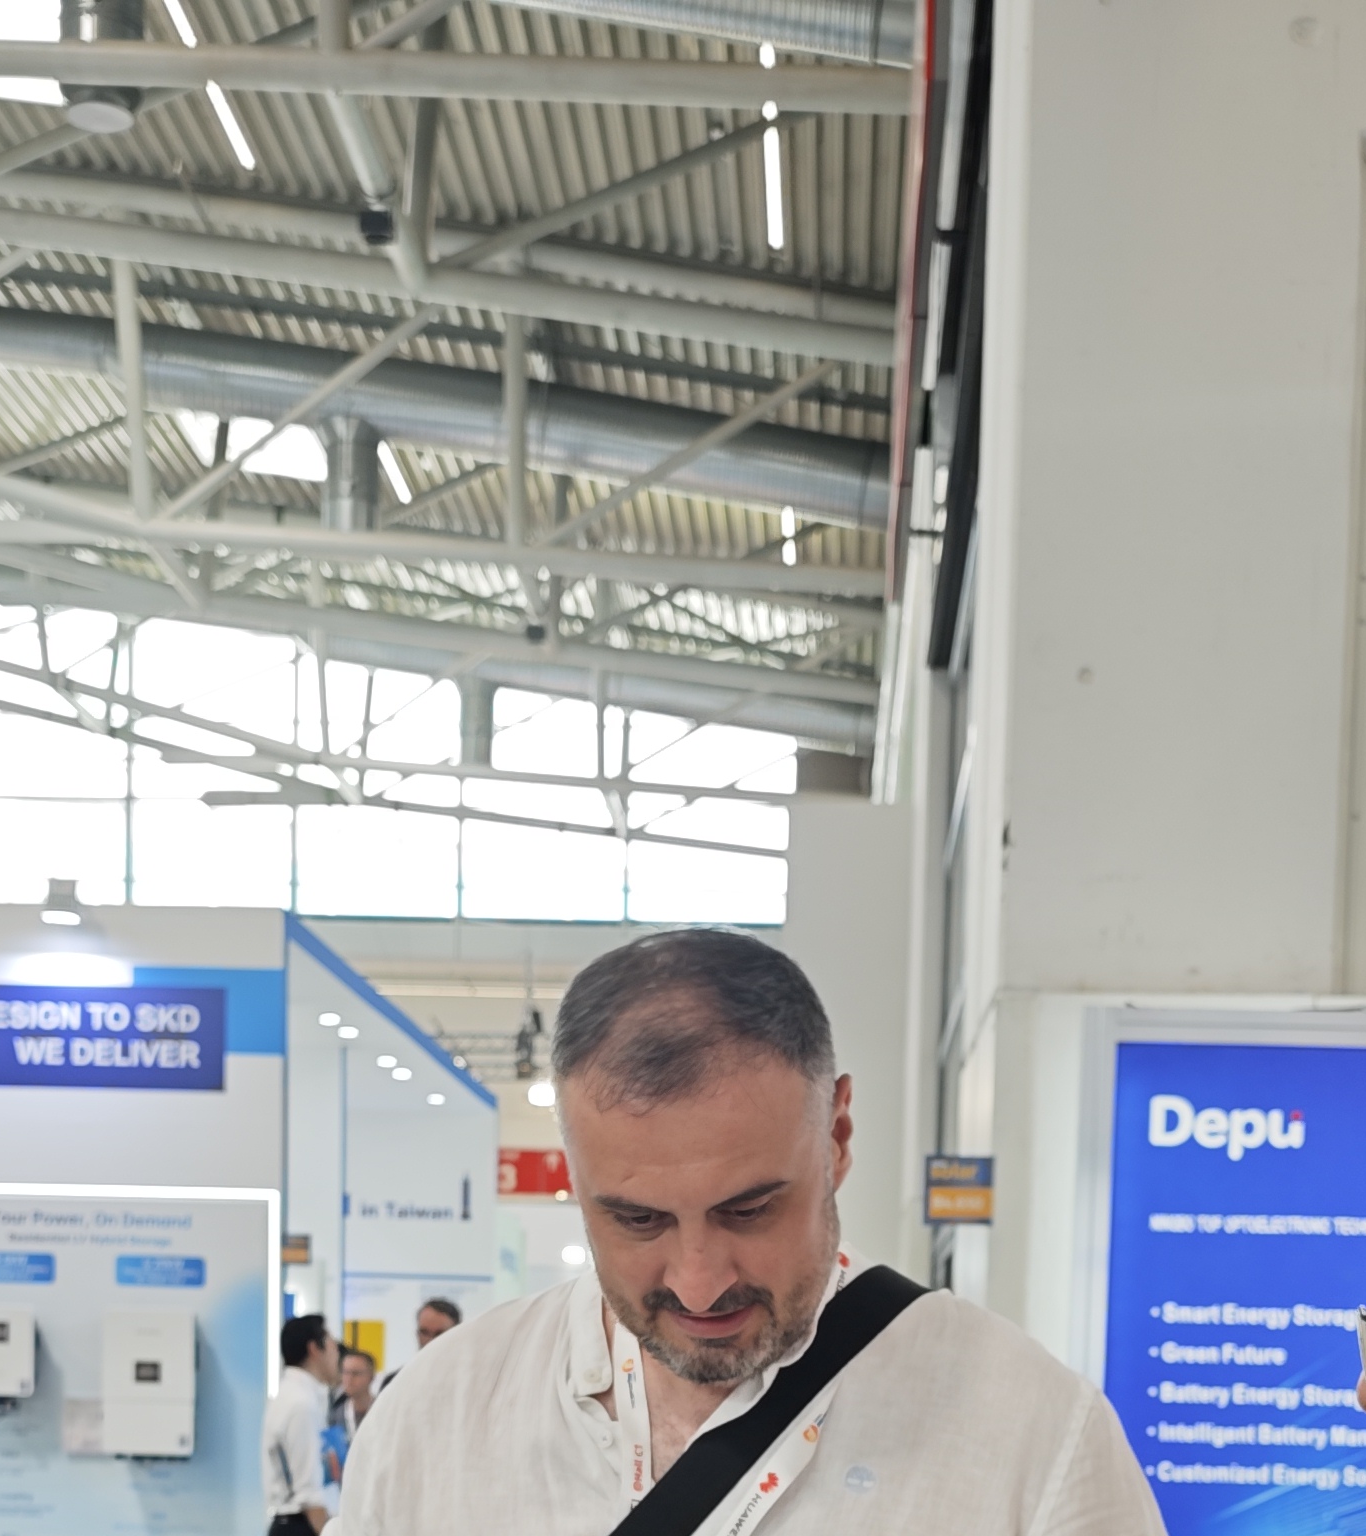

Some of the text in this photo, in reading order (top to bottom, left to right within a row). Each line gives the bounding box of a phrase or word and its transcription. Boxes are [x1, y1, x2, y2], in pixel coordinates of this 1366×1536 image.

[84, 1001, 131, 1032] TO
[135, 1002, 202, 1034] SKD
[12, 1035, 202, 1070] WE DELIVER
[386, 1202, 453, 1220] Taiwan
[1162, 1301, 1358, 1332] Smart Energy Storag
[1160, 1340, 1287, 1366] Green Future
[1159, 1380, 1362, 1412] Battery Energy Stora
[1158, 1420, 1257, 1449] Intelligent
[1257, 1422, 1327, 1451] Battery
[1272, 1462, 1340, 1491] Energy
